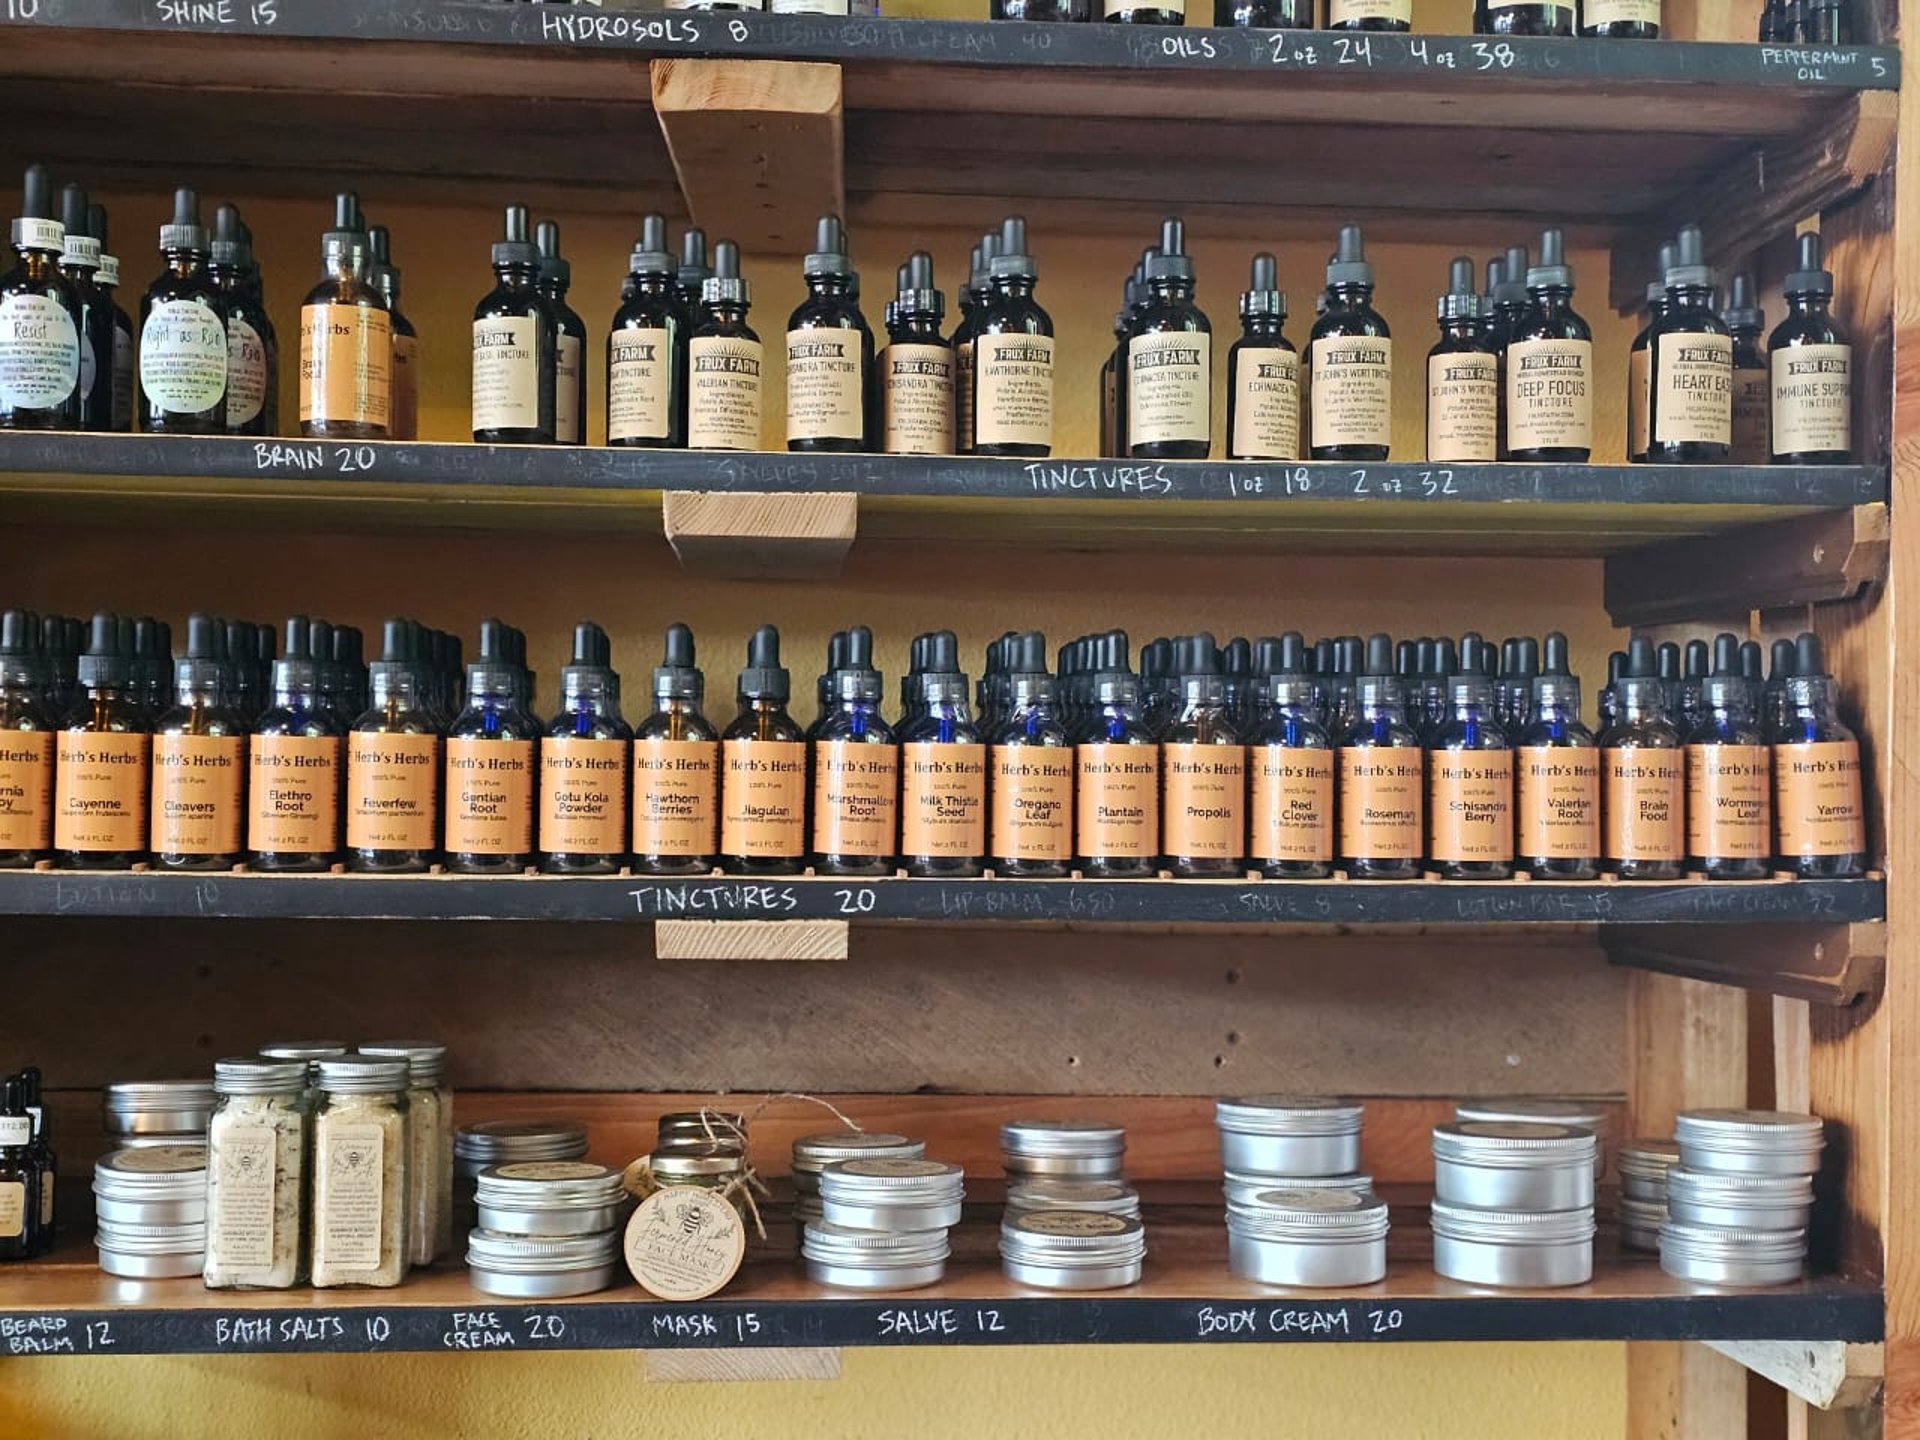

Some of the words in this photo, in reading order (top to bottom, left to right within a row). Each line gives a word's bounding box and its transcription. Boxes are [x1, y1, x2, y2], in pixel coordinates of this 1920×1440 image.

[157, 1, 235, 24] SHINE
[251, 1, 277, 25] 15
[543, 13, 699, 41] HYDROSOLS
[731, 20, 748, 42] 8
[1162, 38, 1216, 58] OILS
[1268, 36, 1287, 64] 2
[1334, 38, 1373, 67] 24
[1410, 38, 1429, 65] 4
[1471, 43, 1515, 68] 38
[1762, 48, 1859, 65] PEPPERMINT
[1798, 67, 1826, 80] OIL
[1871, 58, 1886, 77] 5
[14, 322, 46, 339] Resist
[180, 331, 192, 342] as
[620, 346, 648, 360] FARM
[812, 345, 839, 357] FARM
[1000, 349, 1024, 361] FRUX
[1027, 350, 1049, 362] FARM
[1684, 350, 1709, 361] FRUX
[1137, 354, 1160, 367] FRUX
[1164, 350, 1194, 364] FARM
[1332, 352, 1356, 363] FRUX
[1359, 352, 1382, 363] FARM
[1525, 357, 1548, 368] FRUX
[1552, 355, 1578, 368] FARM
[700, 358, 726, 370] FRUX
[729, 359, 758, 374] FARM
[896, 362, 920, 373] FRUX
[923, 362, 948, 376] FARM
[1264, 365, 1286, 378] FRUX
[1793, 362, 1818, 373] FRUX
[1822, 361, 1846, 372] FARM
[1450, 369, 1474, 380] FRUX
[1249, 381, 1288, 393] ECHINACEA
[1673, 375, 1712, 389] HEART
[1517, 382, 1544, 398] DEEP
[1548, 381, 1585, 396] FOCUS
[1777, 385, 1818, 399] IMMUNE
[1688, 392, 1726, 401] TINCTURE
[1529, 398, 1573, 408] TINCTURE
[1800, 400, 1842, 409] TINCTURE
[254, 443, 323, 469] BRAIN
[335, 446, 376, 472] 20
[1024, 464, 1172, 492] TINCTURES
[1286, 468, 1310, 493] 18
[1353, 471, 1370, 492] 2
[1419, 471, 1459, 495] 32
[61, 751, 95, 763] Herb's
[100, 752, 137, 764] Herbs
[156, 754, 189, 766] Herb's
[194, 755, 232, 767] Herbs
[255, 754, 290, 767] Herb's
[295, 756, 331, 768] Herbs
[355, 751, 391, 763] Herb's
[394, 753, 430, 764] Herbs
[451, 757, 485, 768] Herb's
[489, 759, 523, 769] Herbs
[547, 757, 582, 768] Herb's
[586, 759, 619, 769] Herbs
[638, 758, 672, 769] Herb's
[676, 759, 709, 770] Herbs
[731, 760, 767, 771] Herb's
[915, 762, 951, 773] Herb's
[1001, 764, 1039, 775] Herb's
[1084, 762, 1121, 774] Herb's
[1173, 762, 1211, 773] Herb's
[1794, 761, 1834, 772] Herb's
[1264, 766, 1302, 777] Herb's
[1354, 766, 1393, 776] Herb's
[1442, 768, 1481, 779] Herb's
[1531, 765, 1571, 776] Herb's
[1615, 767, 1655, 777] Herb's
[270, 791, 312, 801] Elethro
[462, 792, 506, 802] Gentian
[555, 792, 580, 802] Gotu
[585, 792, 609, 802] Kola
[646, 794, 699, 804] Hawthorn
[921, 796, 942, 806] Milk
[947, 796, 979, 806] Thistle
[70, 798, 121, 810] Cayenne
[165, 801, 215, 812] Cleavers
[275, 801, 304, 811] Root
[363, 798, 417, 810] Feverfew
[470, 803, 497, 813] Root
[559, 803, 602, 813] Powder
[652, 804, 692, 814] Berries
[1015, 798, 1061, 810] Oregano
[1291, 800, 1312, 810] Red
[1548, 799, 1591, 808] Valerian
[1640, 801, 1668, 810] Brain
[850, 806, 876, 815] Root
[937, 807, 966, 816] Seed
[1026, 810, 1051, 820] Leaf
[1098, 807, 1143, 817] Plantain
[1188, 807, 1231, 820] Propolis
[1282, 810, 1318, 821] Clover
[1558, 809, 1583, 818] Root
[1640, 811, 1668, 821] Food
[1738, 809, 1761, 818] Leaf
[1465, 812, 1496, 824] Berry
[629, 886, 797, 912] TINCTURES
[834, 889, 875, 912] 20
[1, 1318, 67, 1336] BEARD
[453, 1313, 501, 1329] FACE
[524, 1315, 565, 1338] 20
[878, 1310, 958, 1335] SALVE
[977, 1310, 1006, 1332] 12
[1198, 1308, 1256, 1335] BODY
[1269, 1309, 1349, 1334] CREAM
[1369, 1310, 1402, 1333] 20
[216, 1319, 270, 1344] BATH
[280, 1318, 344, 1342] SALTS
[366, 1317, 390, 1342] 10
[653, 1315, 718, 1337] MASK
[736, 1314, 761, 1341] 15
[86, 1322, 115, 1349] 12
[443, 1332, 514, 1349] CREAM
[10, 1336, 74, 1353] BALM
